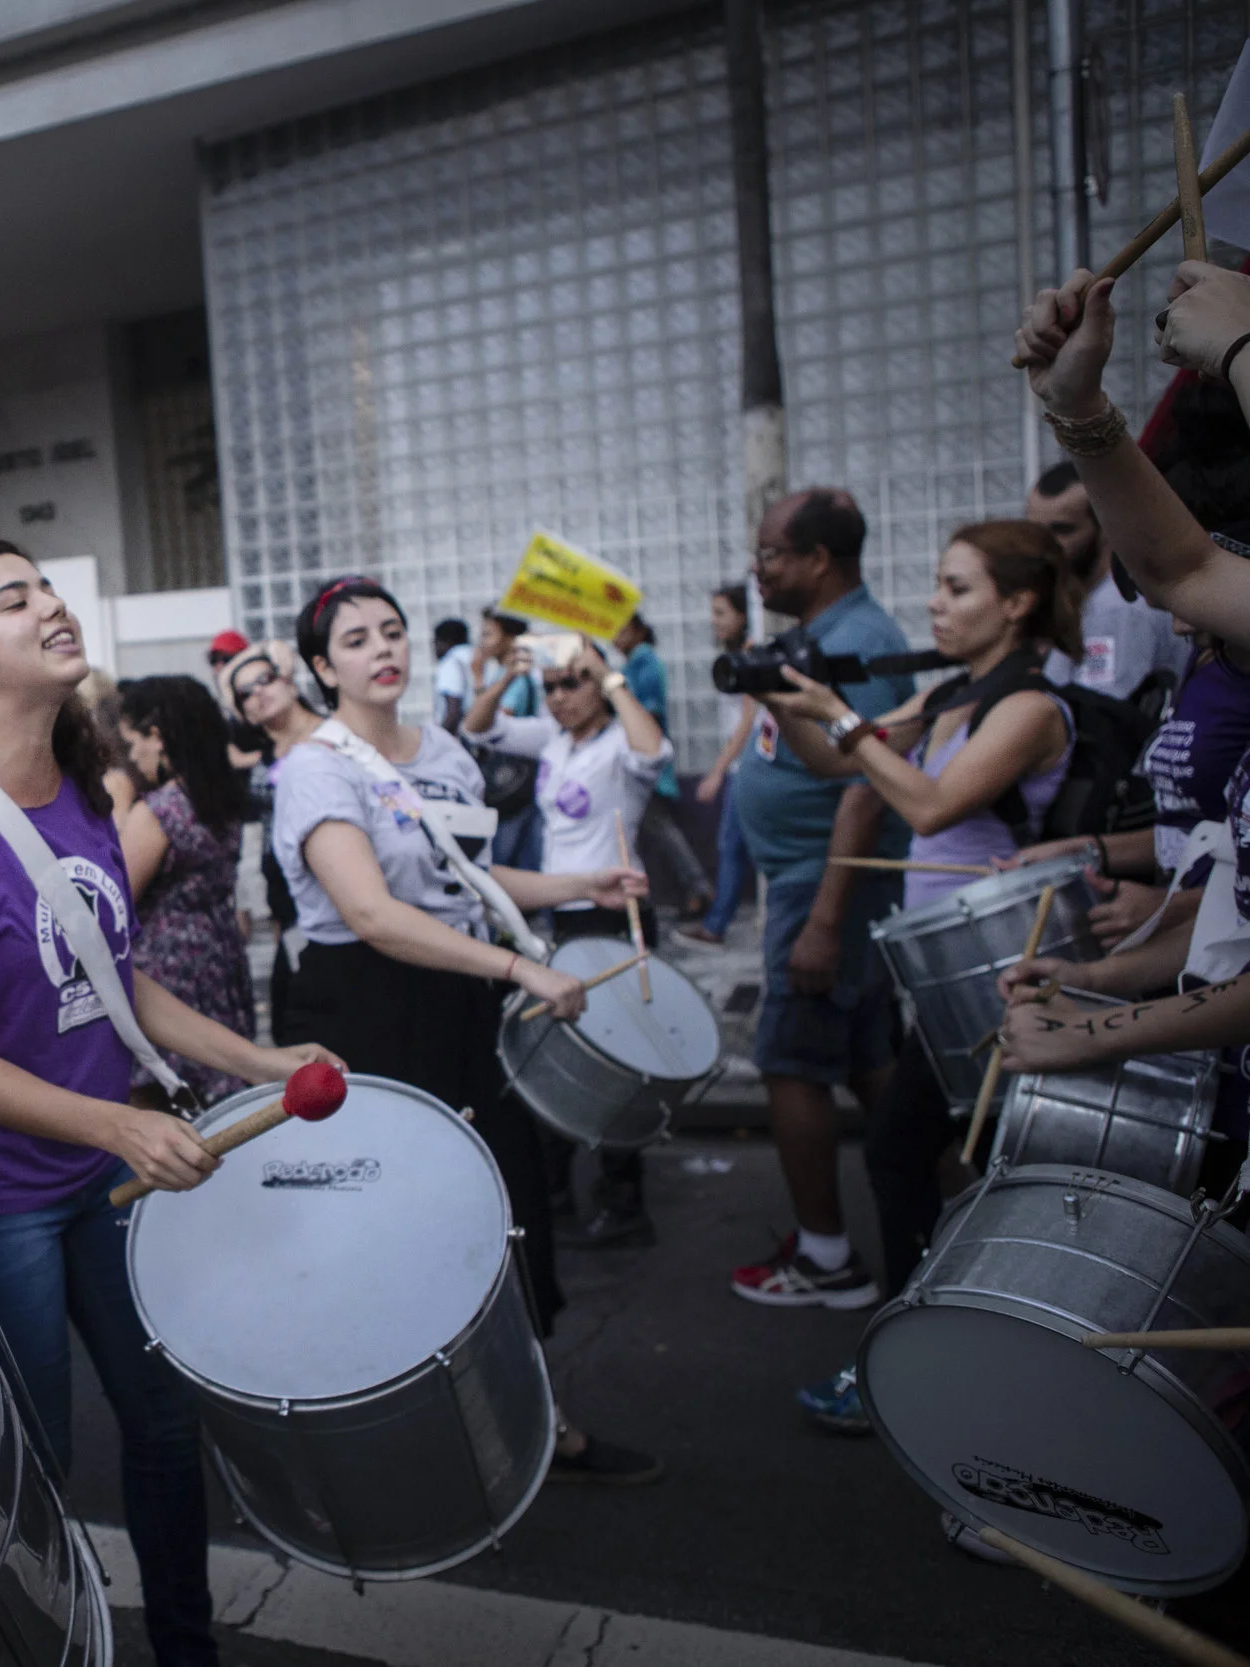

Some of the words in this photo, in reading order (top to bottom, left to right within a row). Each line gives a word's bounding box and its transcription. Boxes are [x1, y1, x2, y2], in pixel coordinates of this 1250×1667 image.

[74, 863, 97, 880] em
[102, 873, 125, 916] Luta
[60, 981, 95, 1004] CS
